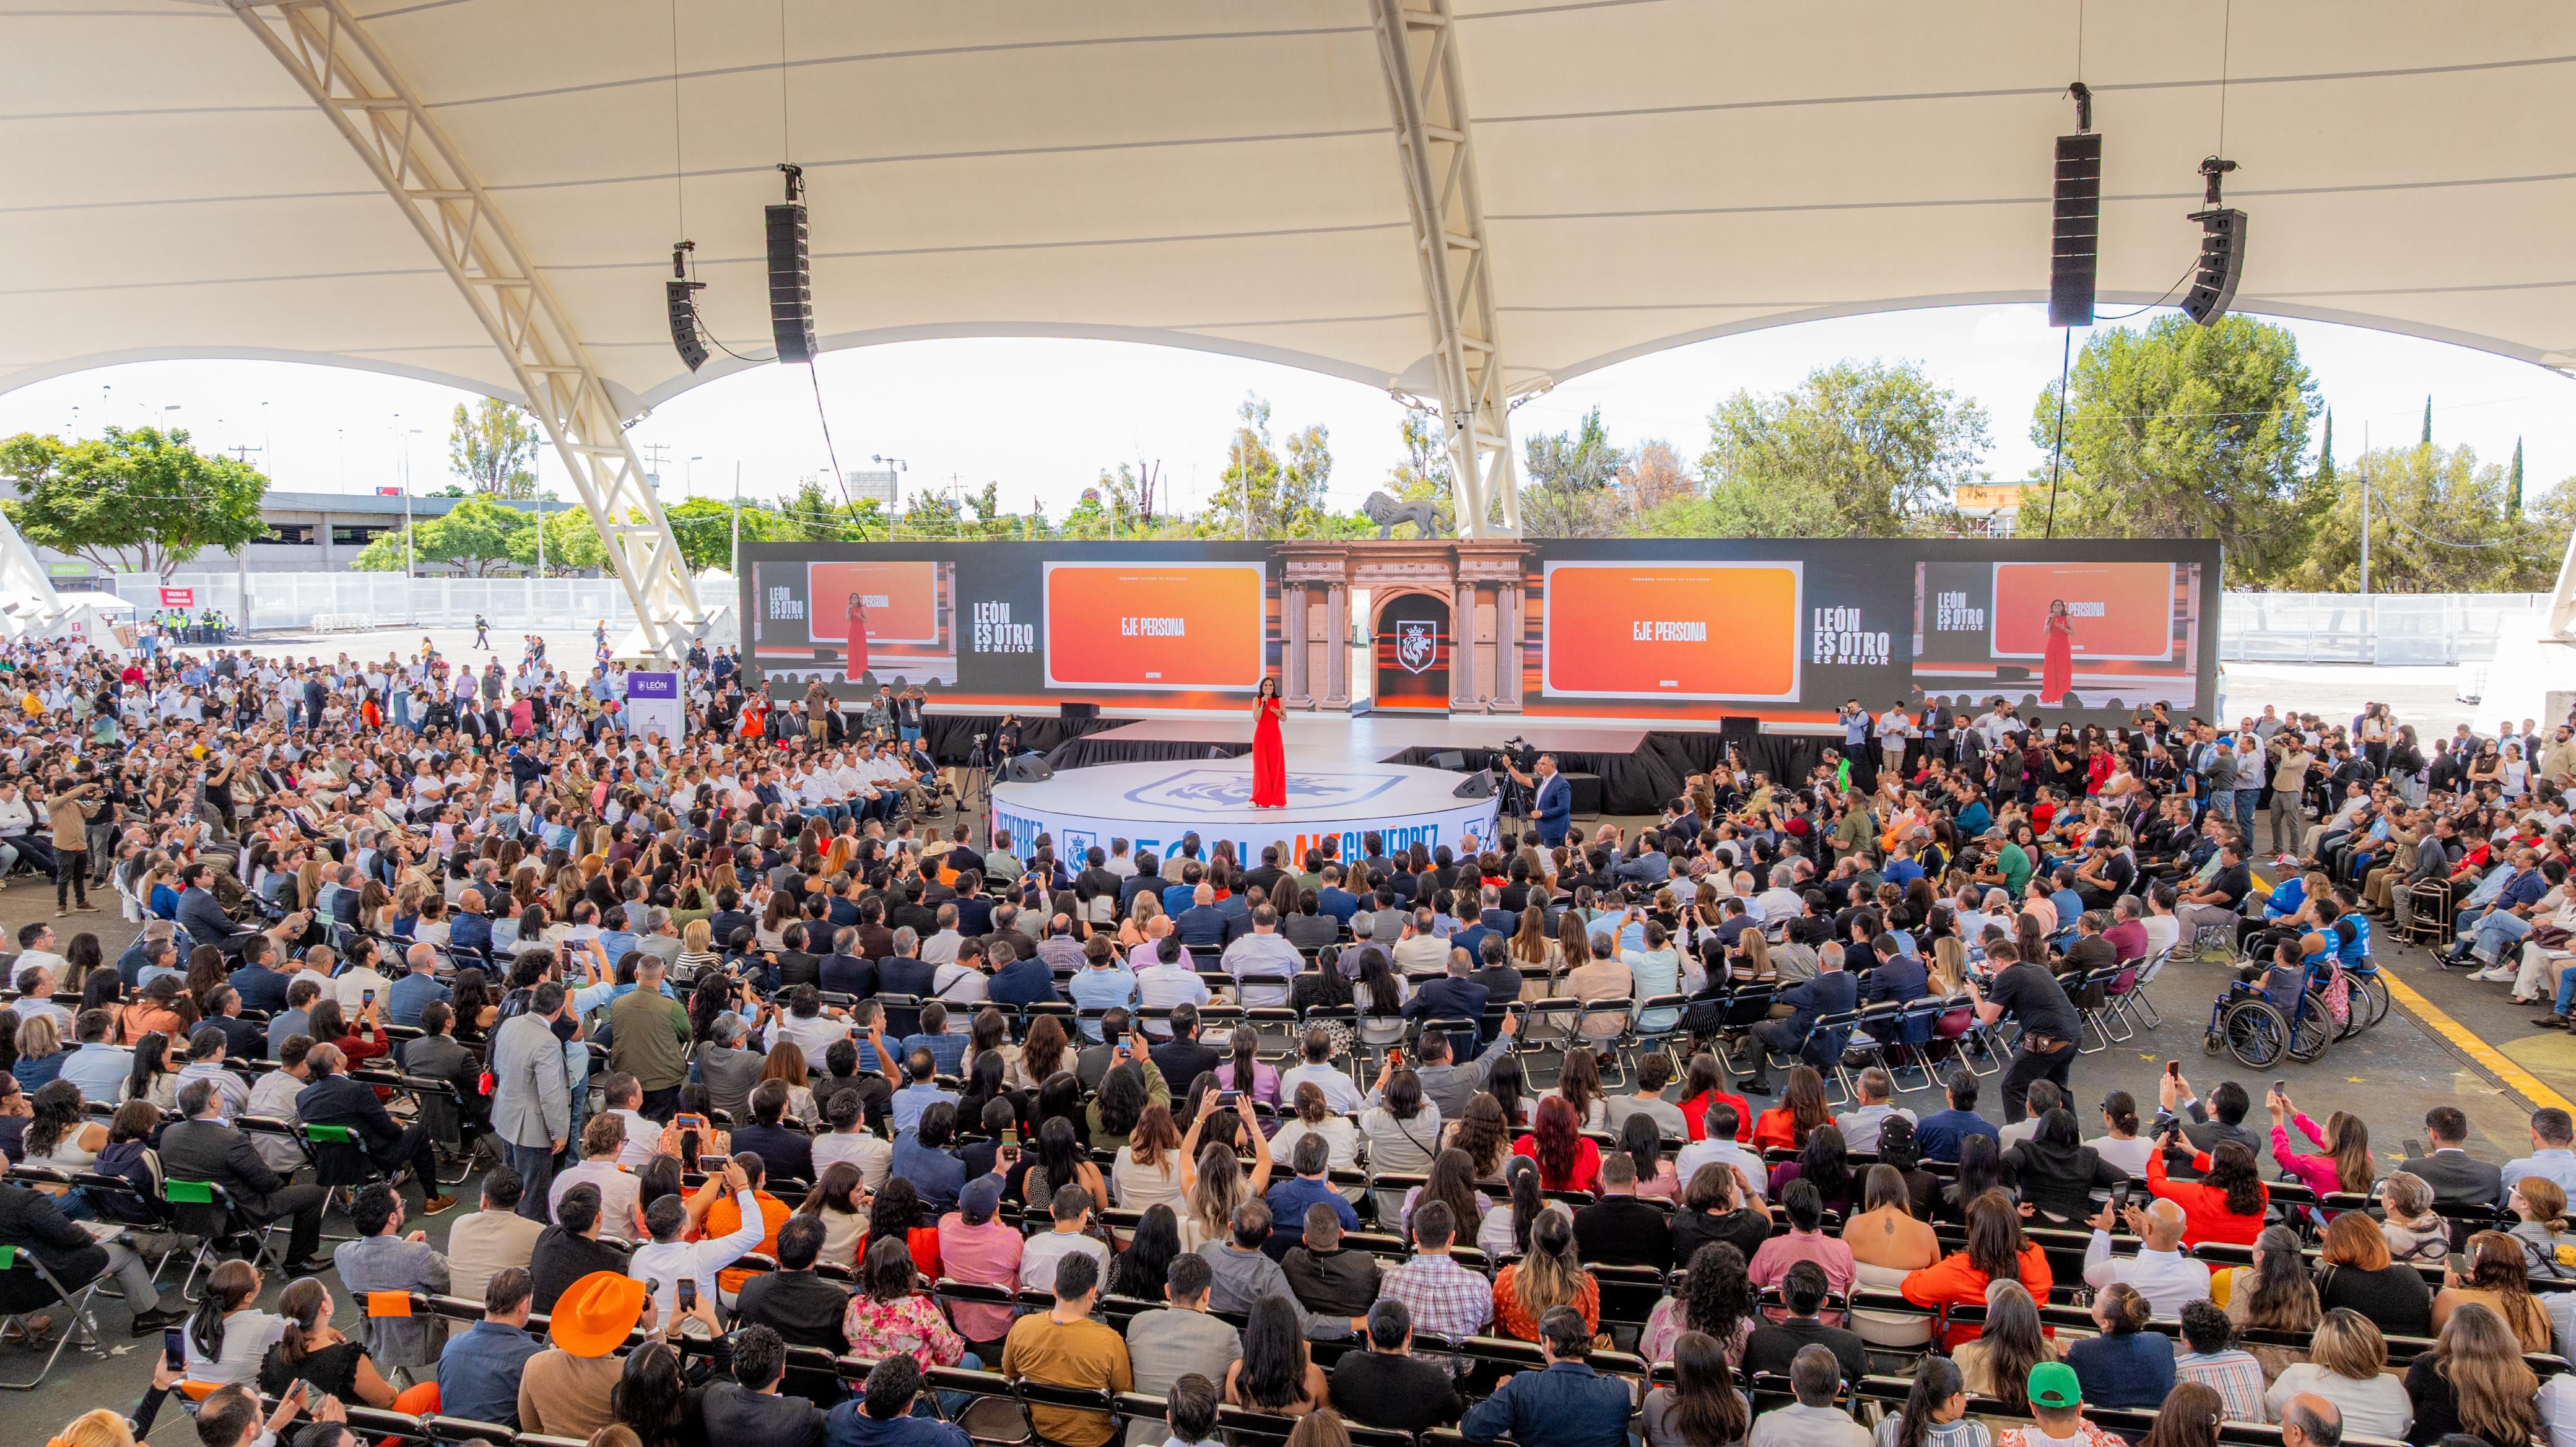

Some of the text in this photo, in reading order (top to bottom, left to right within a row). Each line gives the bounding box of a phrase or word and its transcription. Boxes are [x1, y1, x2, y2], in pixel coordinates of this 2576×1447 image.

[770, 586, 790, 601] LEÓN
[863, 595, 889, 607] PERSONA
[1938, 591, 1966, 609] LEÓN
[770, 601, 803, 615] ES OTRO
[974, 600, 1010, 624] LEÓN
[1938, 608, 1983, 625] ES OTRO
[2069, 602, 2105, 617] PERSONA
[1121, 617, 1185, 636] EJE PERSONA
[1814, 605, 1861, 632] LEÓN
[975, 624, 1033, 645] ES OTRO
[1634, 621, 1707, 641] EJE PERSONA
[975, 645, 1033, 653] ES MEJOR
[1814, 631, 1890, 656] ES OTRO
[1813, 655, 1889, 665] ES MEJOR
[646, 680, 668, 689] LEÓN
